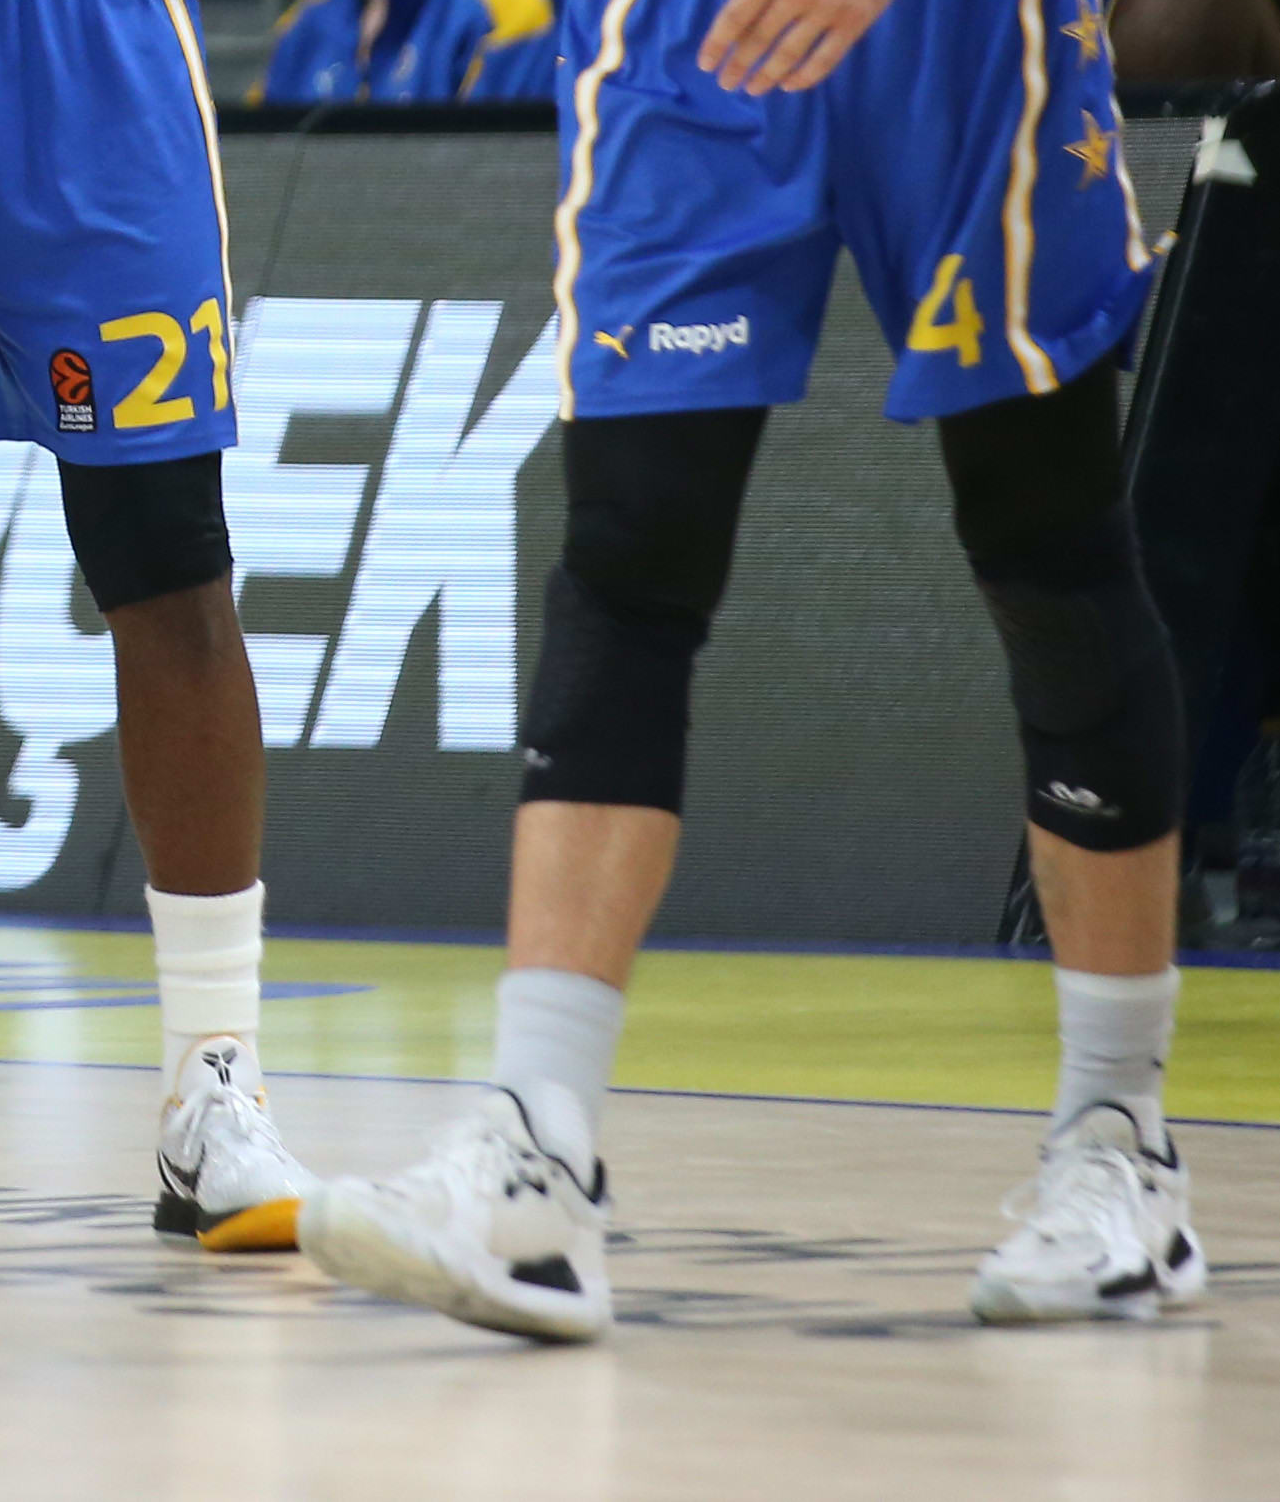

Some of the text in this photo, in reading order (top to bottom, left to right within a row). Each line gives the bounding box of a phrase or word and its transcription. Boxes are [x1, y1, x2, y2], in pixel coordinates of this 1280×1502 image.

[100, 297, 229, 429] 21
[649, 314, 749, 354] Rapyd
[907, 253, 984, 367] 4
